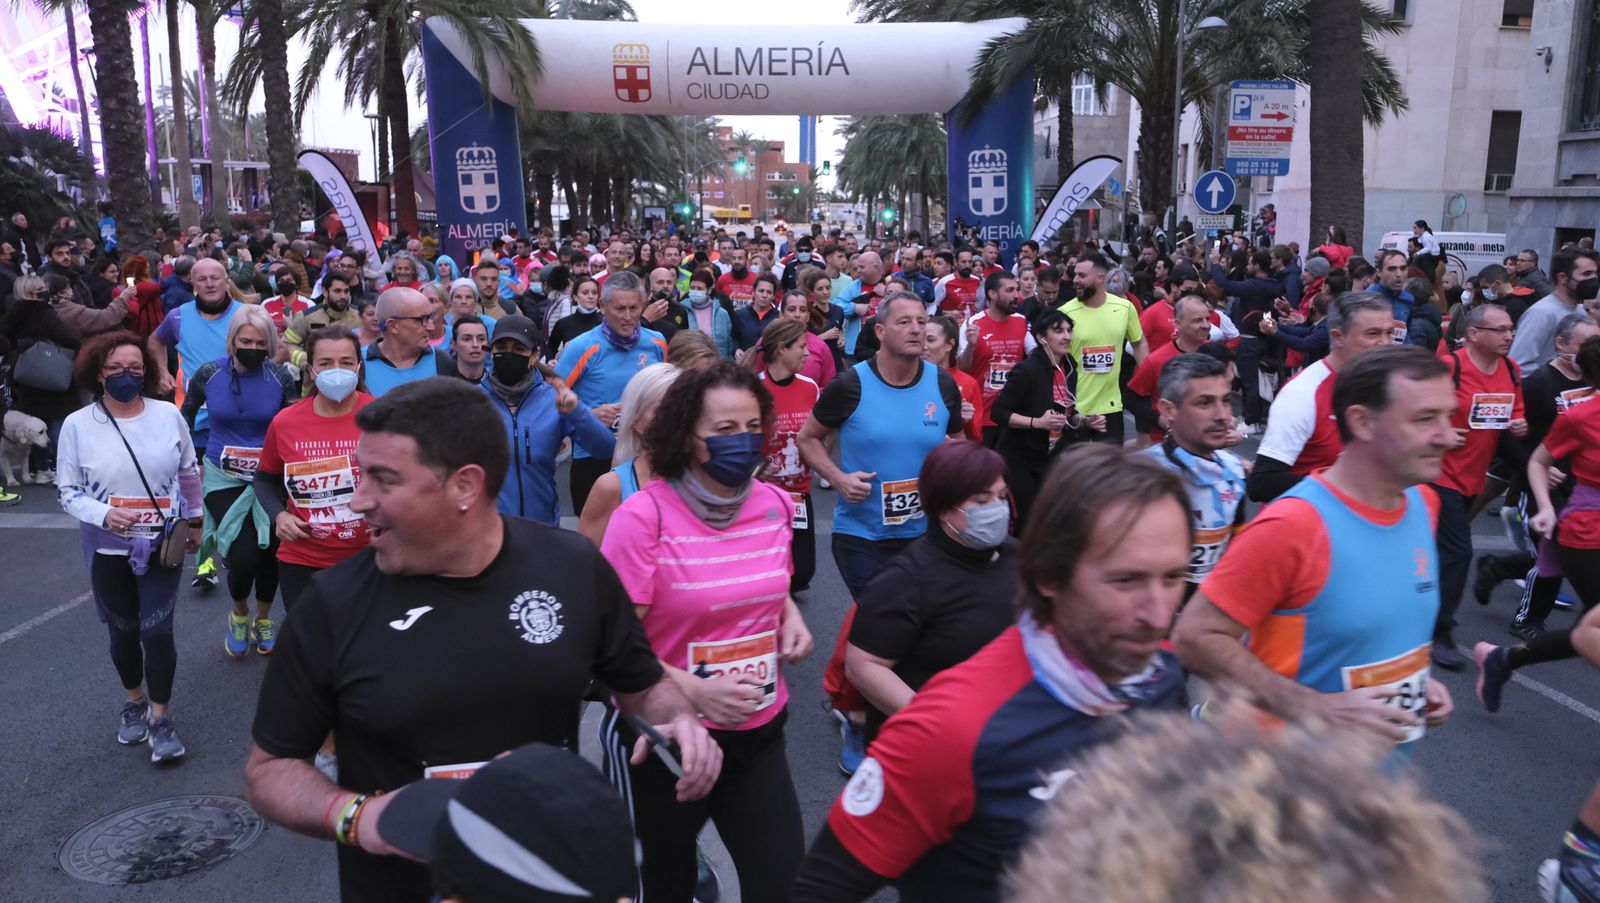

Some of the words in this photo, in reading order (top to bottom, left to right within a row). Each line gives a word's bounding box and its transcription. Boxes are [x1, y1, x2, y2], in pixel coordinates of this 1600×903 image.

[687, 41, 850, 76] ALMERÍA
[686, 82, 770, 100] CIUDAD
[1235, 95, 1250, 114] P
[976, 221, 1024, 241] MERÍA
[1089, 354, 1112, 363] 426
[1479, 406, 1506, 416] 3263
[231, 458, 258, 470] 322
[297, 474, 341, 491] 3477
[895, 492, 919, 510] 32
[136, 512, 161, 524] 227
[1192, 546, 1218, 565] 27
[509, 589, 562, 620] BOMBEROS
